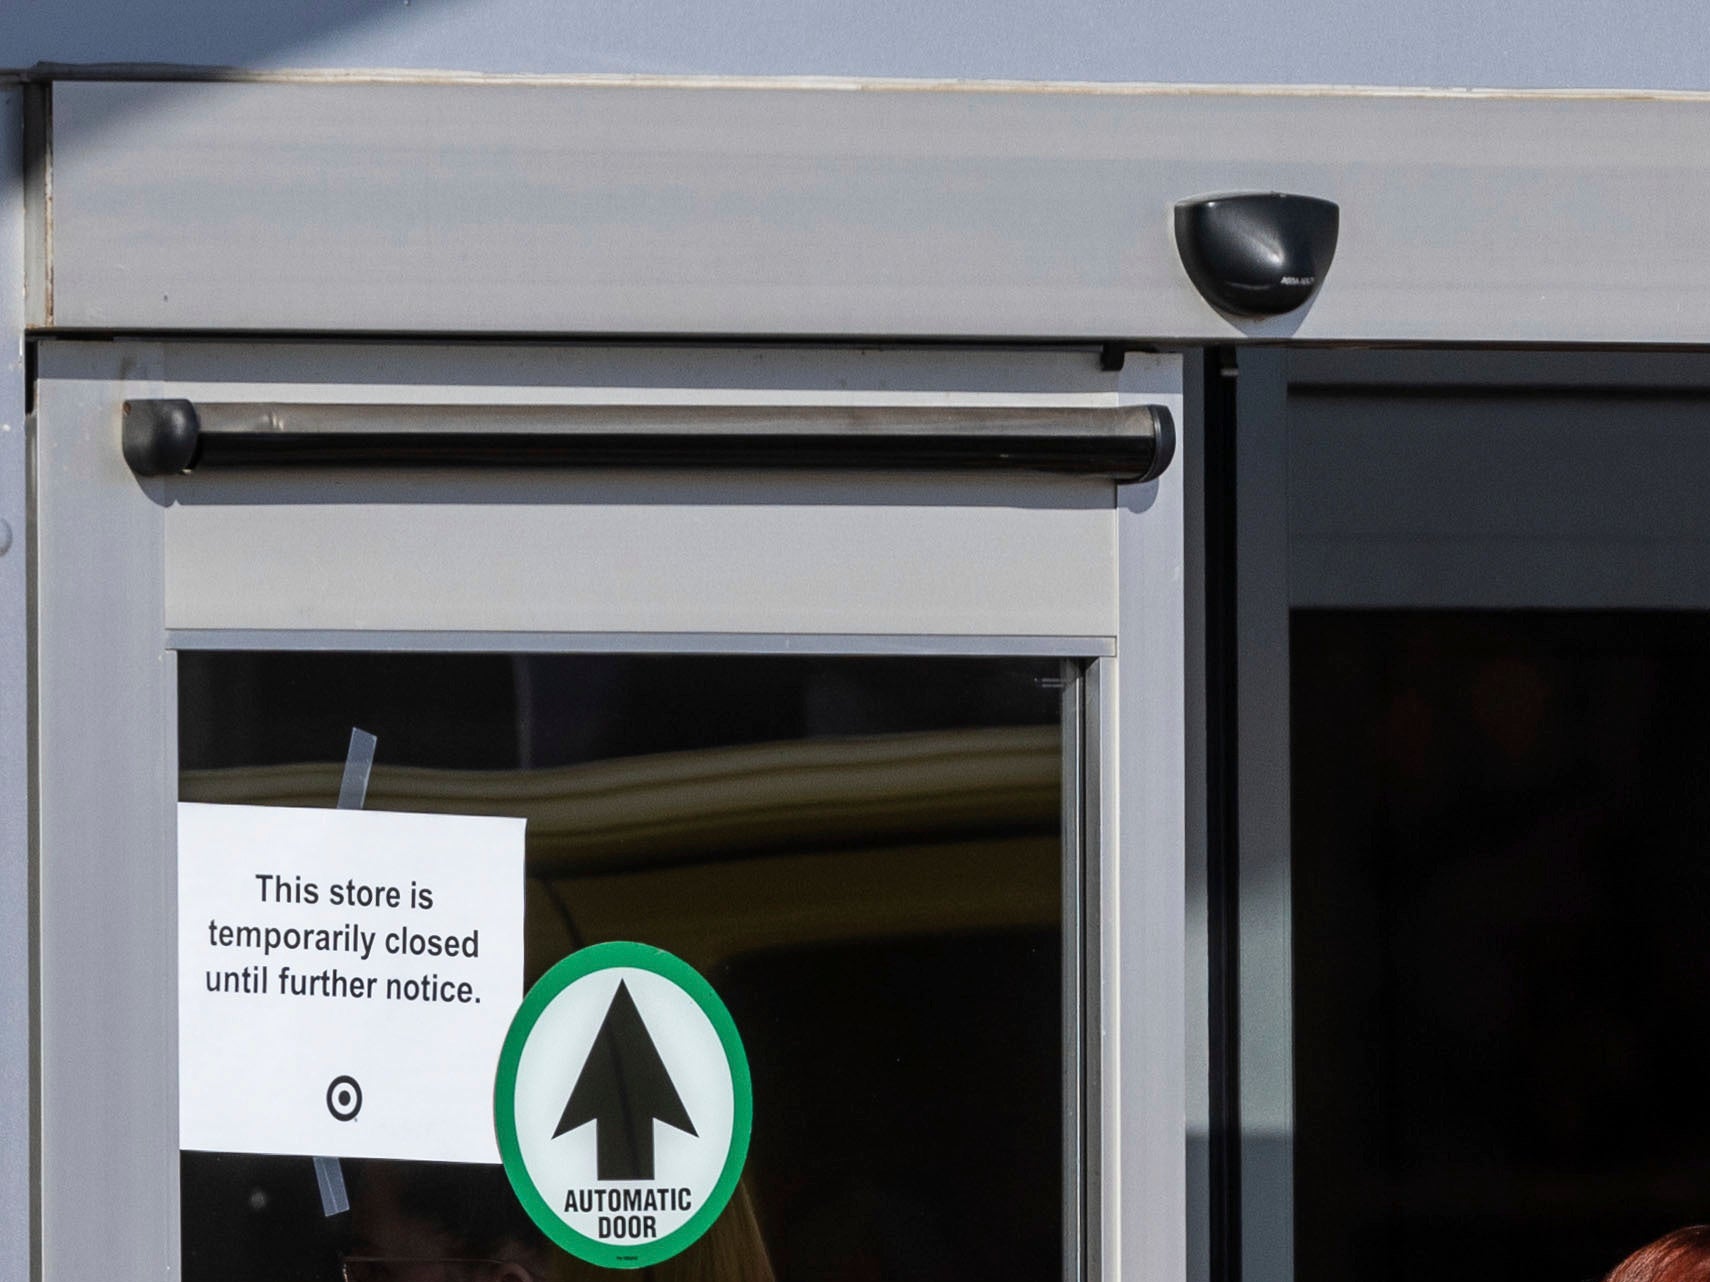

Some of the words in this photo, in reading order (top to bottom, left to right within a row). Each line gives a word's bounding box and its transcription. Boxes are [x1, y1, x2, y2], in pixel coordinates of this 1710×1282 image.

[255, 873, 320, 907] This
[330, 878, 401, 909] store
[409, 878, 433, 910] is
[208, 918, 376, 962] temporarily
[386, 925, 479, 959] closed
[205, 965, 269, 996] until
[278, 966, 377, 1000] further
[386, 970, 481, 1004] notice.
[564, 1188, 692, 1212] AUTOMATIC
[599, 1216, 657, 1239] DOOR
